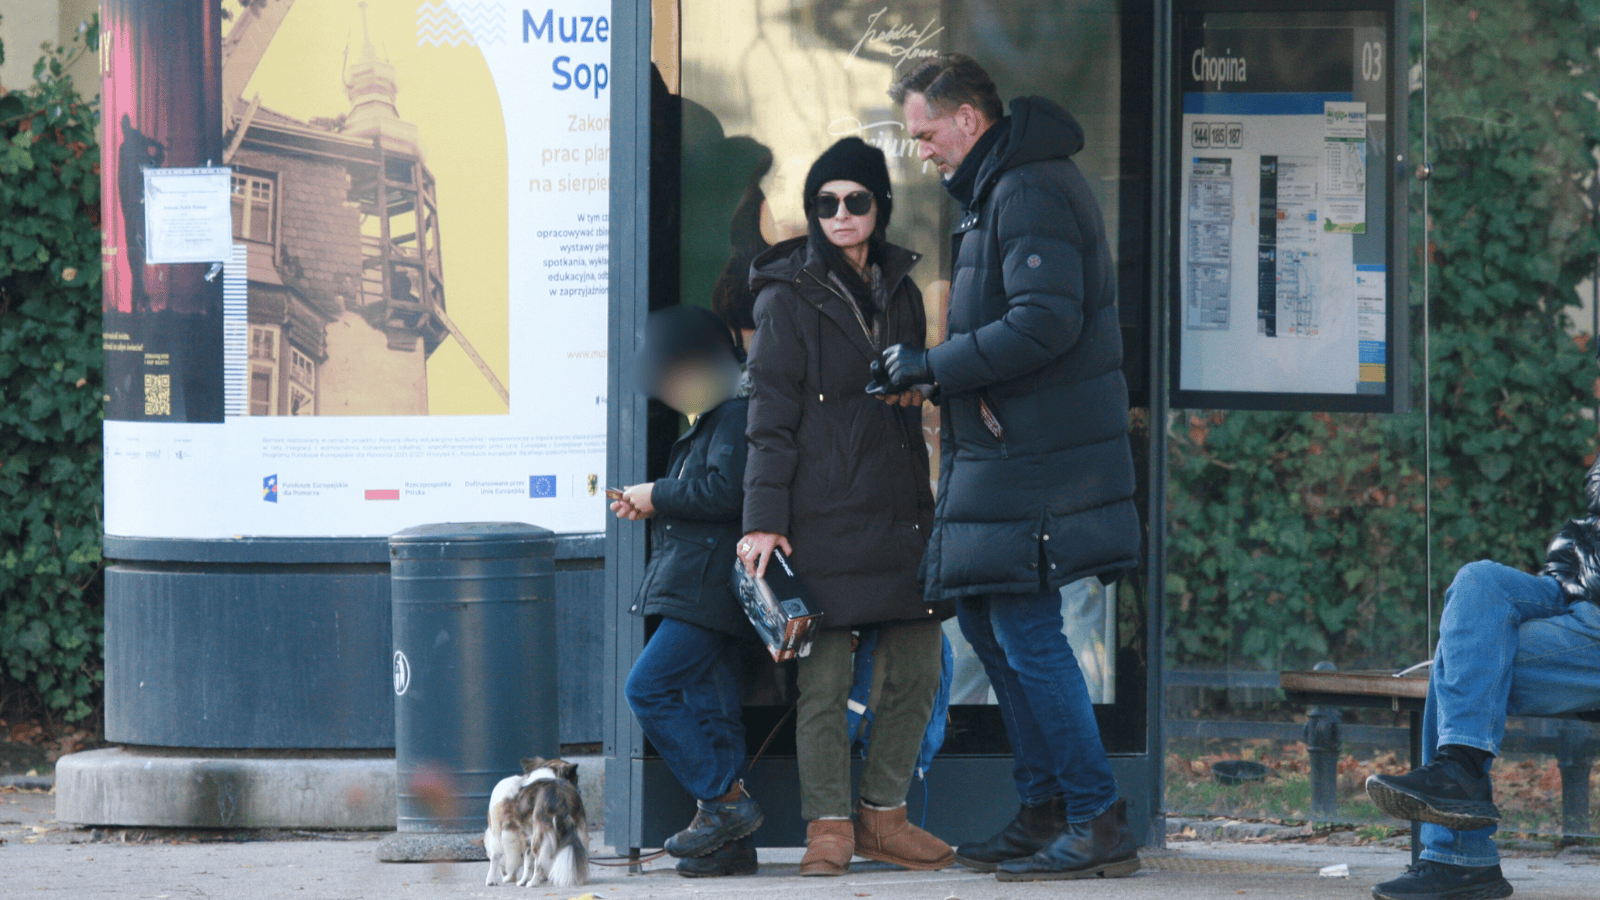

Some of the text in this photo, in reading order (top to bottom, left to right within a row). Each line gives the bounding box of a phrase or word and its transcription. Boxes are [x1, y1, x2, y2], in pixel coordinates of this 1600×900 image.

[1192, 42, 1382, 91] Chopina 03
[1194, 128, 1241, 144] 144 185 187
[541, 147, 580, 166] prac
[529, 178, 552, 192] na
[577, 213, 585, 222] W
[587, 214, 600, 224] tym
[536, 228, 594, 240] opracowywać
[560, 244, 593, 254] wystawy
[543, 256, 587, 269] spotkania,
[547, 271, 596, 283] edukacyjna,
[549, 288, 557, 296] w
[312, 482, 348, 490] Europejskie
[404, 481, 452, 489] Rzeczpospolita
[465, 480, 525, 488] Dofinansowane przez
[495, 488, 525, 496] Europejską
